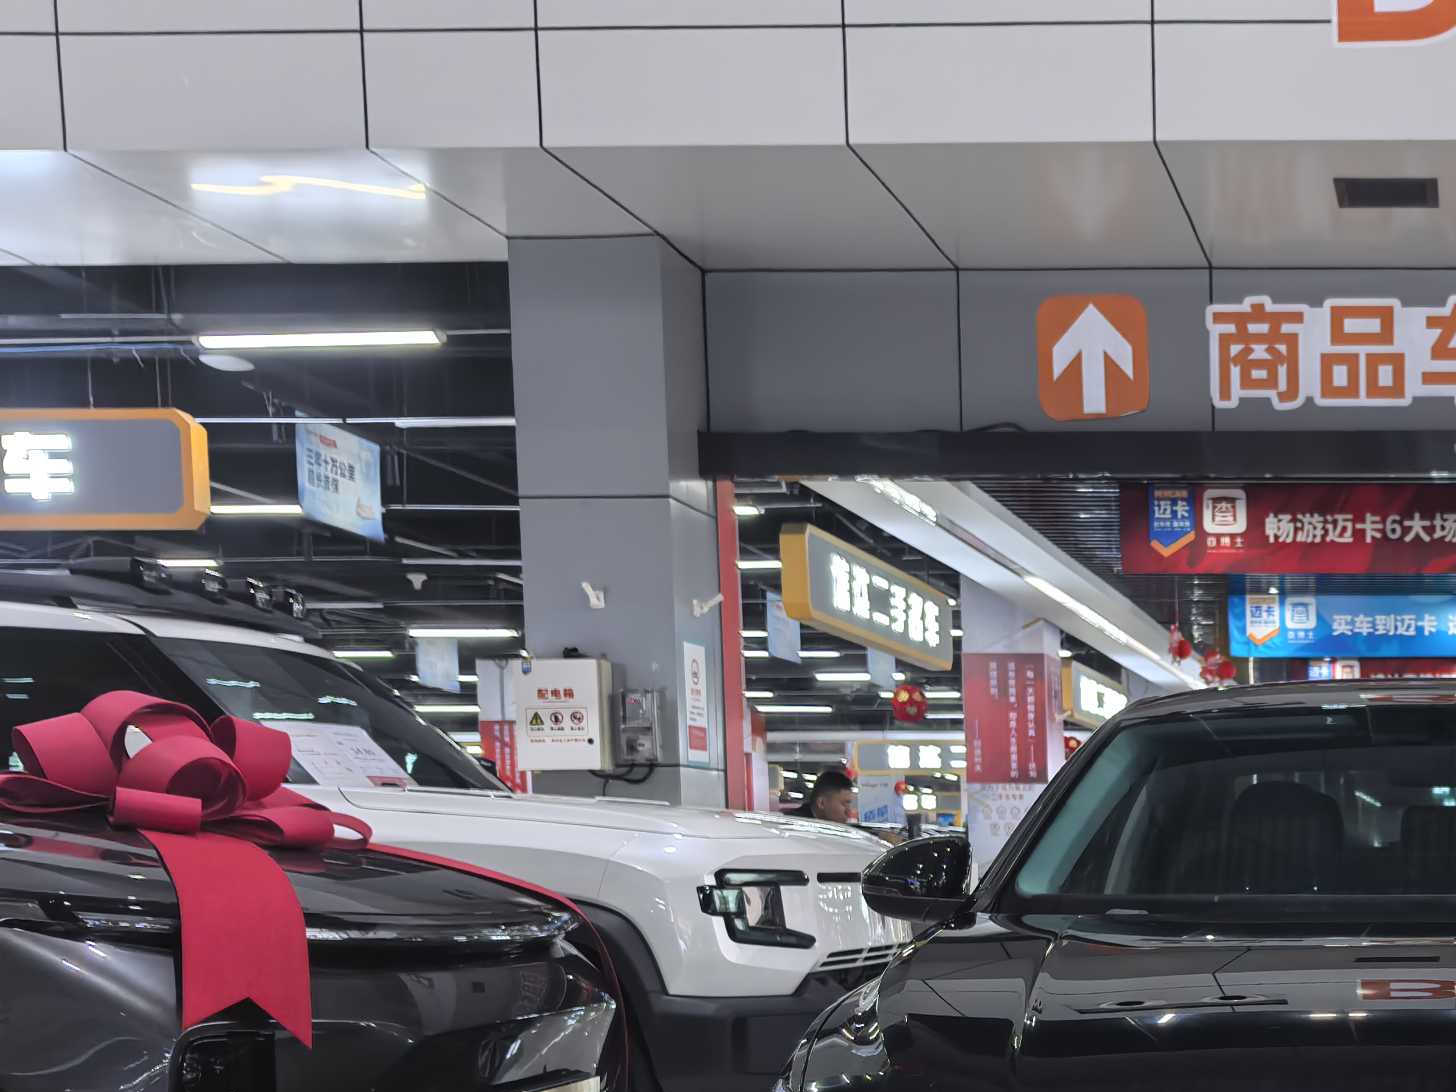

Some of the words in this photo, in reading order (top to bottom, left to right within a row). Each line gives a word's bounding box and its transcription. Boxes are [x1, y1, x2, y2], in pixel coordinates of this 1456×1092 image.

[1, 431, 75, 501] 车
[1154, 500, 1190, 519] 迈卡
[1332, 613, 1438, 637] 买车到迈卡
